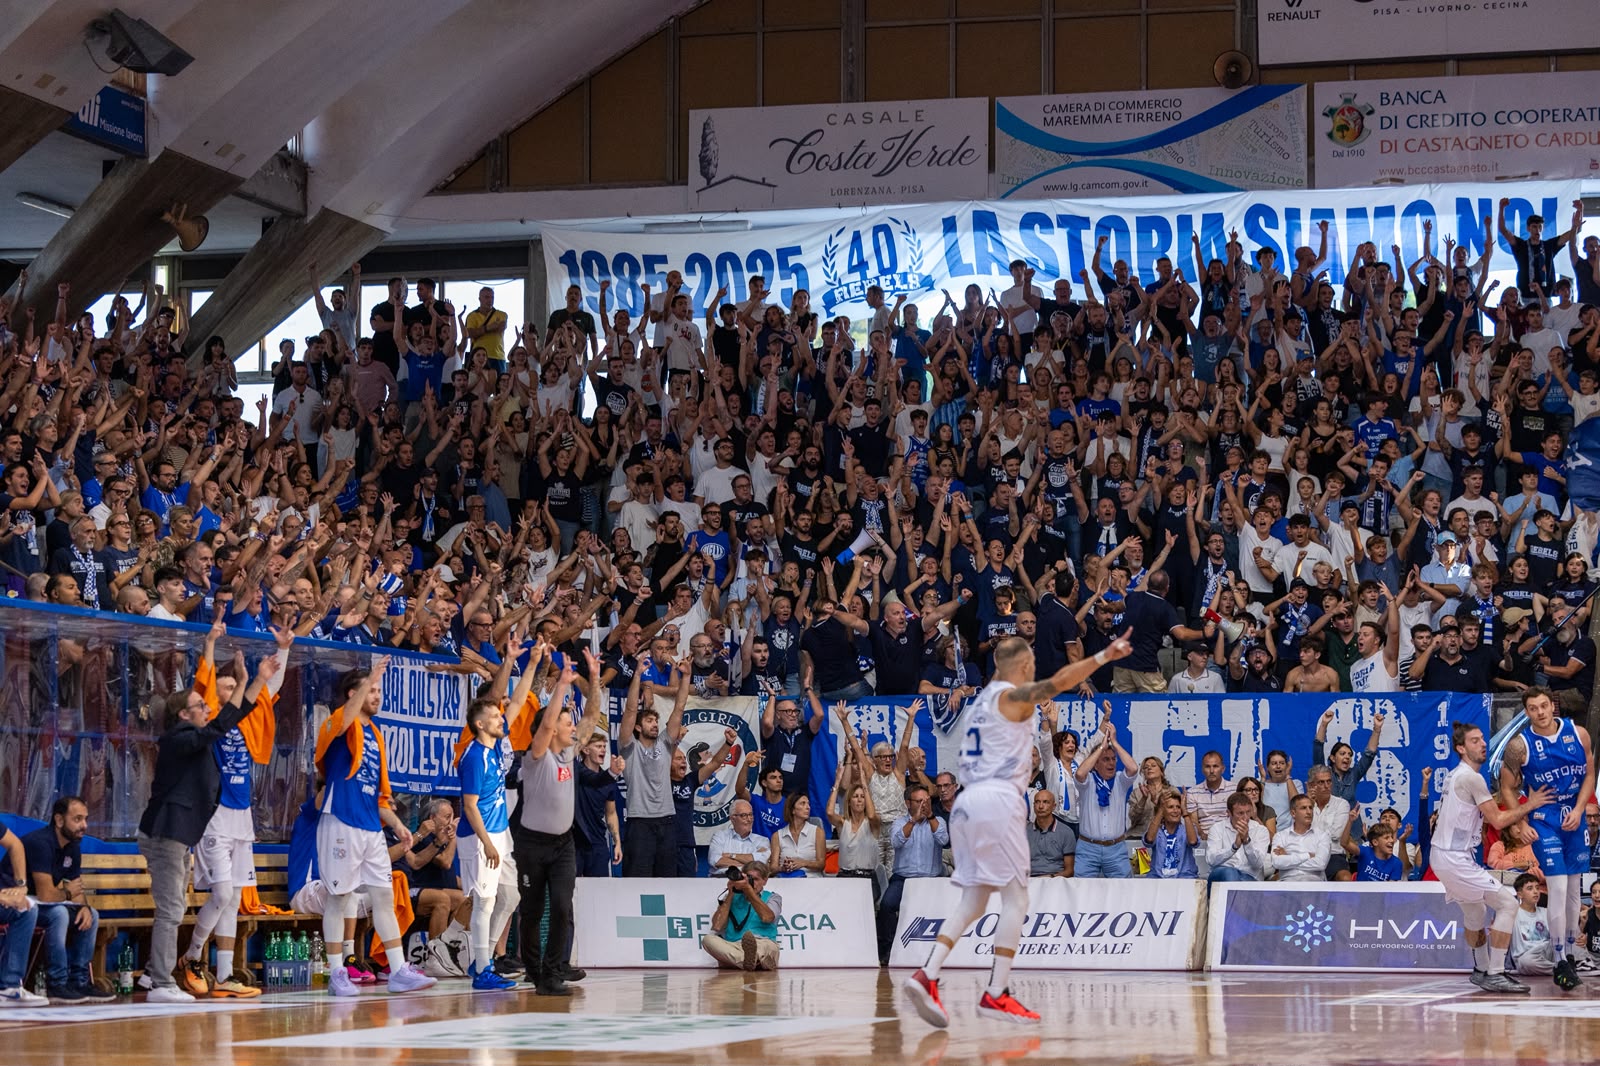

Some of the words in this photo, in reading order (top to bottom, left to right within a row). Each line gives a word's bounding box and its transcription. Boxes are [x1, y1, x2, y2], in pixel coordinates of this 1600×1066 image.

[1267, 9, 1322, 22] RENAULT
[1373, 8, 1400, 16] PISA
[1483, 1, 1529, 10] CECINA
[1043, 102, 1096, 114] CAMERA
[1097, 101, 1107, 112] DI
[1108, 97, 1182, 111] COMMERCIO
[1379, 89, 1447, 106] BANCA
[825, 109, 925, 126] CASALE
[1043, 113, 1113, 127] MAREMMA
[1115, 113, 1122, 123] E
[1123, 110, 1183, 123] TIRRENO
[1379, 115, 1398, 129] DI
[1406, 111, 1487, 129] CREDITO
[99, 117, 126, 138] Missione
[125, 127, 144, 144] lavoro
[1247, 118, 1290, 161] Turismo
[1379, 139, 1399, 154] DI
[1403, 134, 1529, 153] CASTAGNETO
[768, 128, 877, 176] Costa
[871, 124, 981, 178] Verde
[1331, 149, 1345, 158] Dal
[1346, 149, 1365, 158] 1910
[1207, 164, 1305, 188] Innovazione
[1378, 162, 1501, 177] www.bcccastagneto.it
[900, 184, 925, 195] PISA
[1042, 178, 1149, 193] www.lg.camcom.gov.it
[847, 223, 898, 281] 40
[380, 663, 462, 721] BALAUSTRA
[1534, 739, 1545, 753] 8
[1583, 829, 1590, 846] 8
[1364, 864, 1390, 882] PIELLE
[695, 913, 837, 931] FACIA
[1349, 919, 1457, 941] HVM
[1064, 941, 1133, 956] NAVALE
